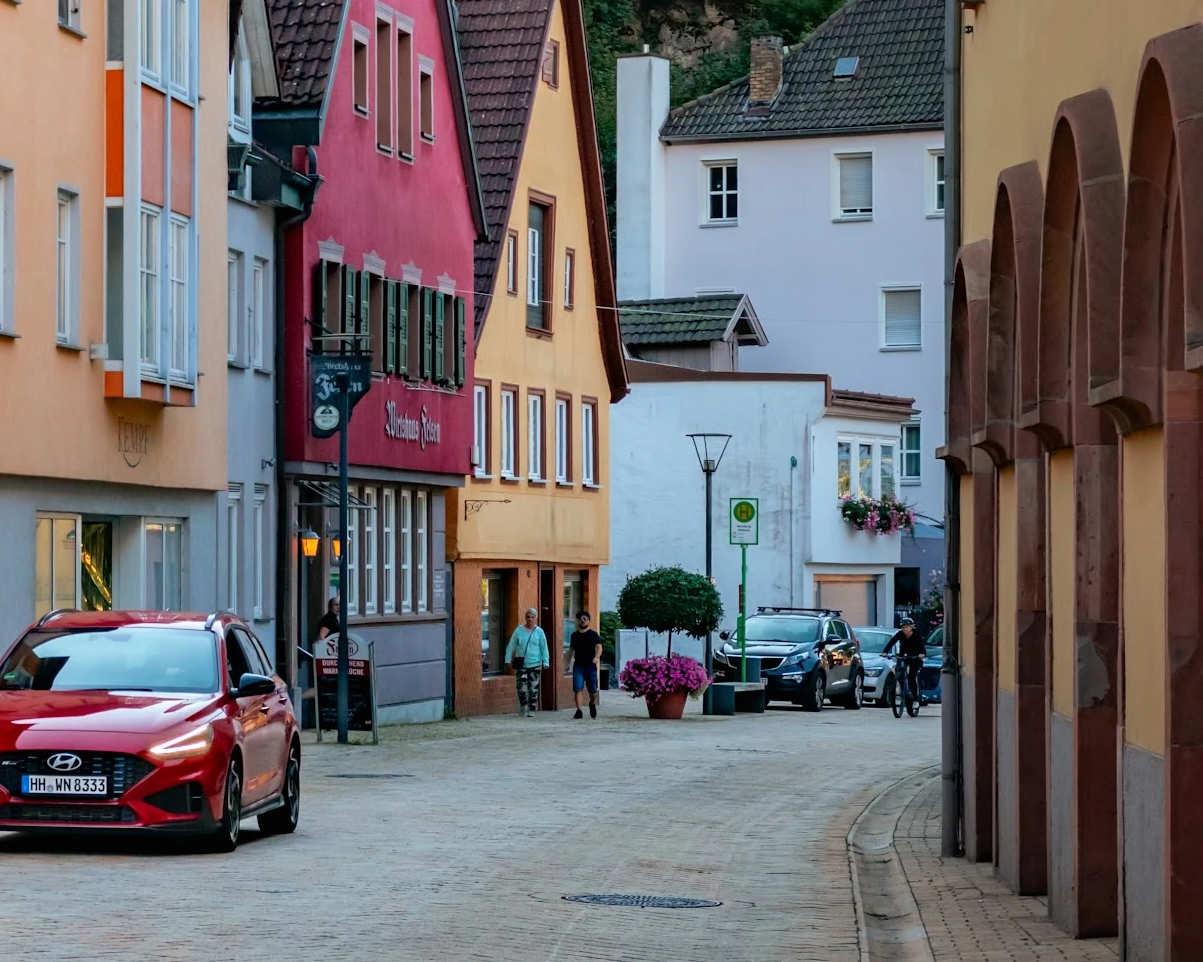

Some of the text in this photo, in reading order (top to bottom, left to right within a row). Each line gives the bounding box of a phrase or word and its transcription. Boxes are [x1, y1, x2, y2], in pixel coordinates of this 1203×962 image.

[385, 399, 440, 450] Wirtshaus Felsen
[347, 668, 364, 676] ÜCHE
[30, 778, 105, 792] HH WN 8333
